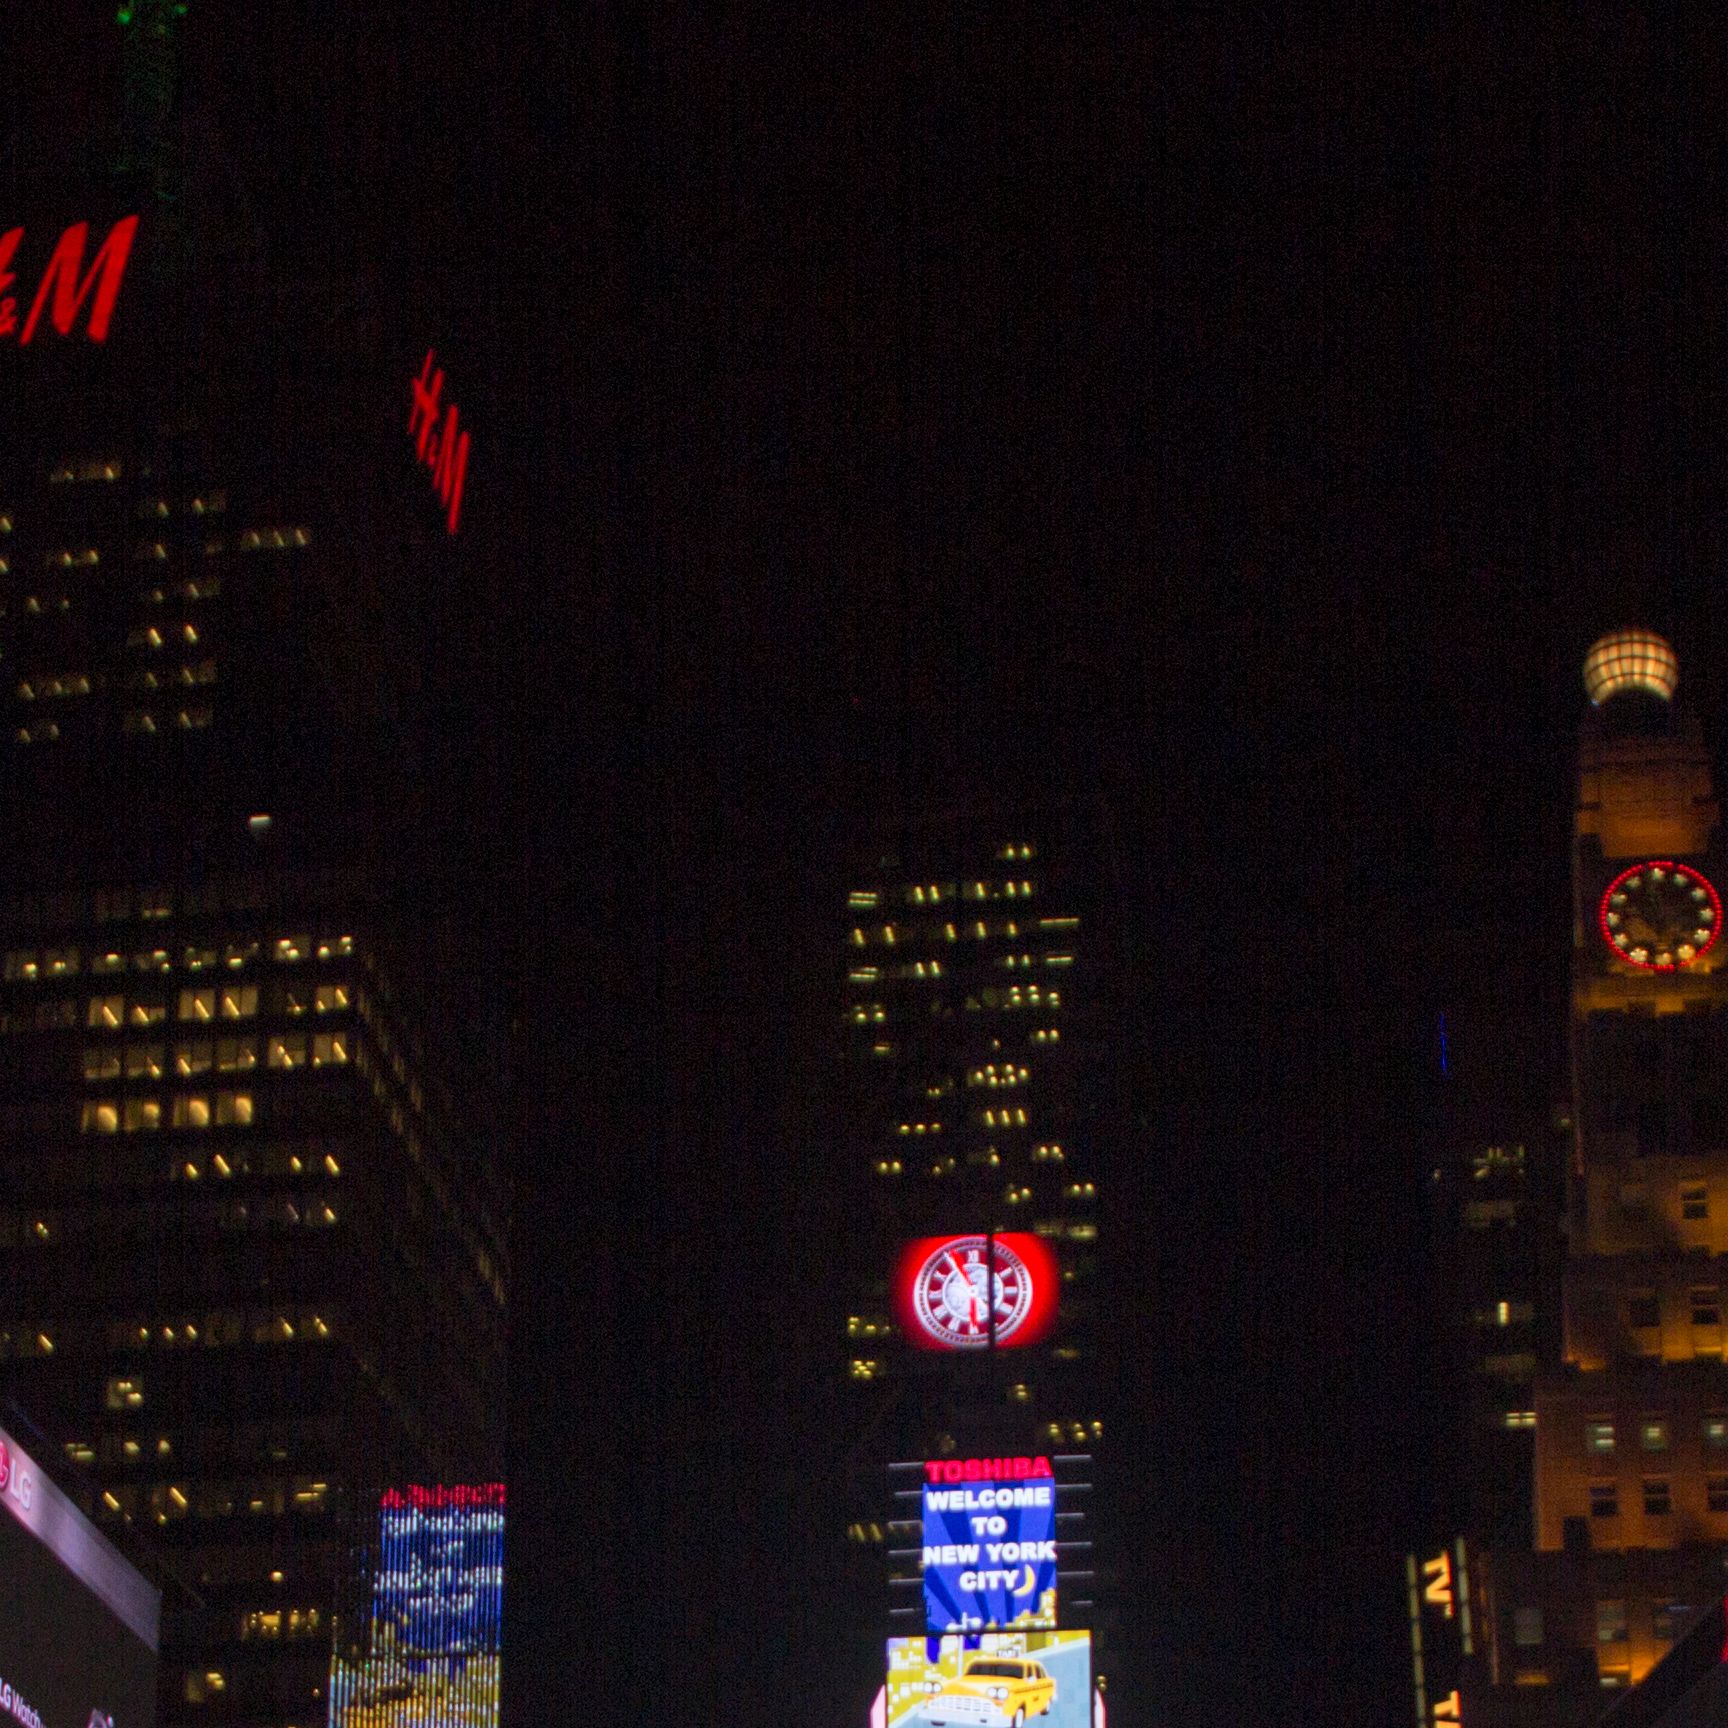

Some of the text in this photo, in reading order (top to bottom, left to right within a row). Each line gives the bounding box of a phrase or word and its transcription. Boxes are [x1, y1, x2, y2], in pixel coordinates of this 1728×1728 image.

[407, 350, 470, 535] H&M
[924, 1455, 1053, 1483] TOSHIBA
[8, 1470, 33, 1509] LG
[925, 1486, 1052, 1512] WELCOME
[971, 1515, 1007, 1537] TO
[922, 1540, 1058, 1566] NEW YORK
[958, 1569, 1019, 1592] CITY
